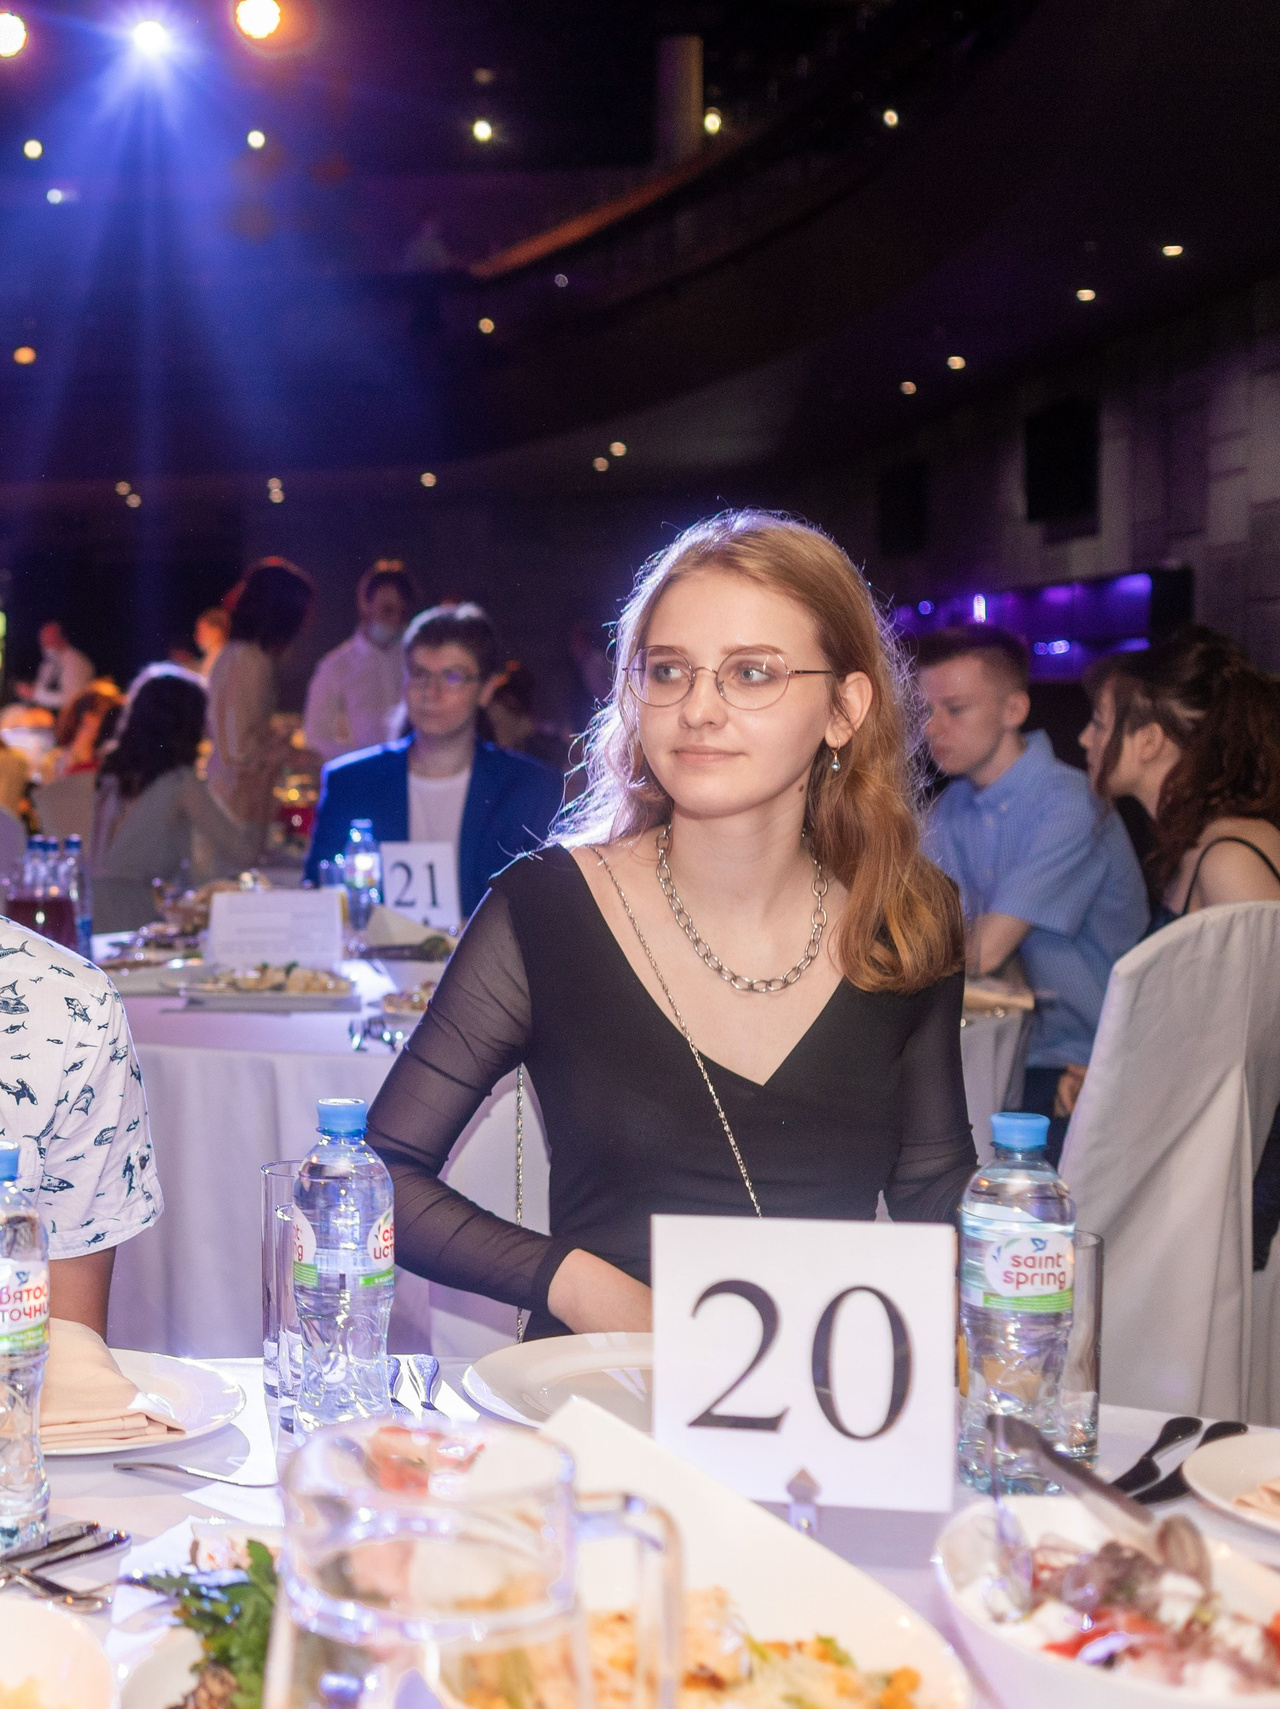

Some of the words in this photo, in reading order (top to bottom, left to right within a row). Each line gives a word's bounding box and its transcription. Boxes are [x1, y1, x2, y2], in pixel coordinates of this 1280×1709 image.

[390, 861, 439, 908] 21
[1010, 1252, 1064, 1270] saint
[1002, 1270, 1067, 1291] spring
[687, 1278, 914, 1442] 20
